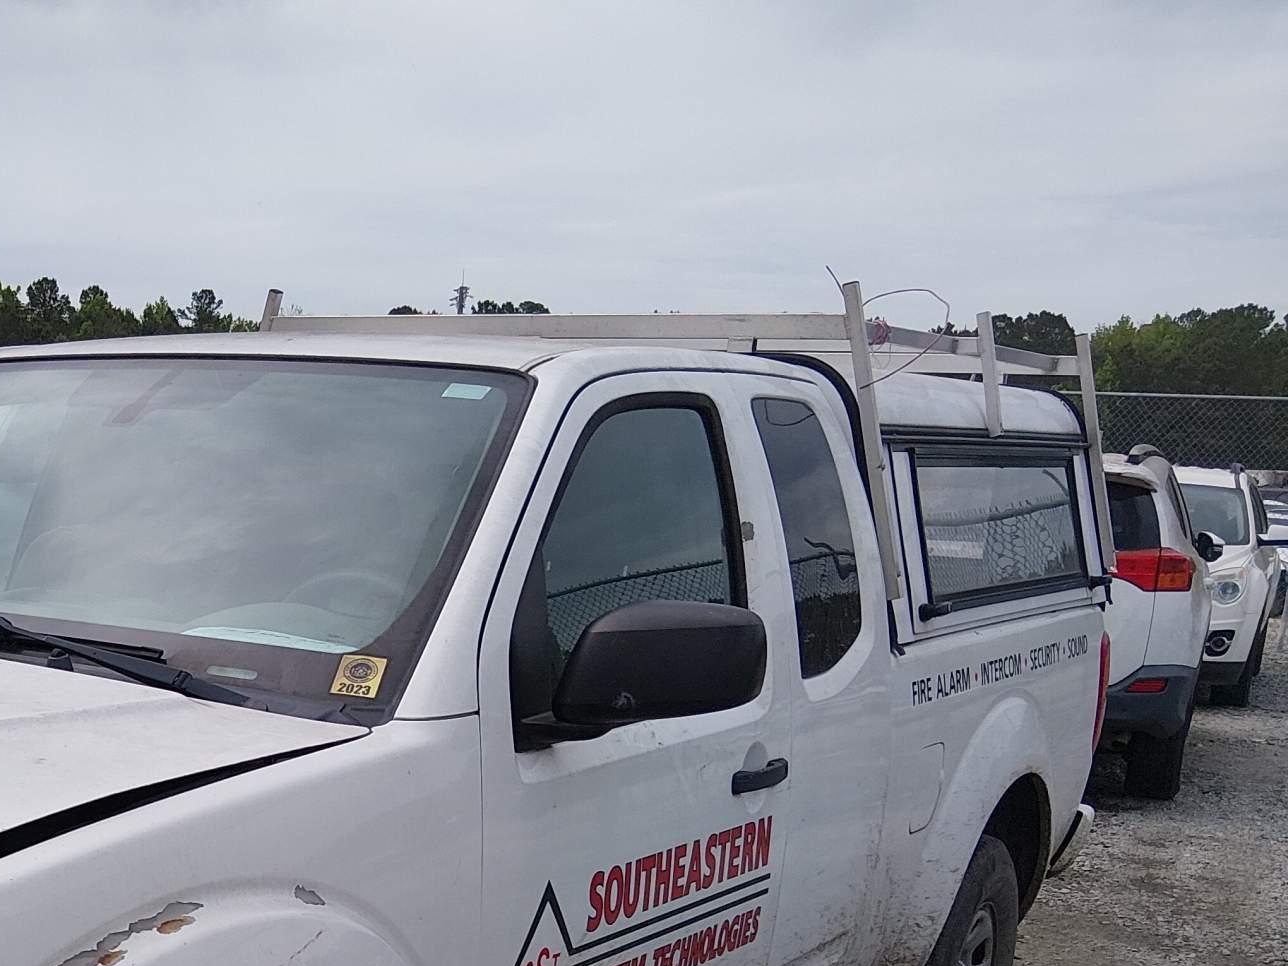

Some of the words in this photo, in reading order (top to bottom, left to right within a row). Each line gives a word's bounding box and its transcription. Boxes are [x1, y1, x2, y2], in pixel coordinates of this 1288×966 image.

[337, 683, 371, 696] 2023
[912, 677, 933, 706] FIRE
[936, 667, 971, 699] ALARM
[980, 653, 1022, 686] INTERCOM
[1029, 642, 1061, 671] SECURITY
[1067, 634, 1088, 659] SOUND
[586, 815, 773, 932] SOUTHEASTERN
